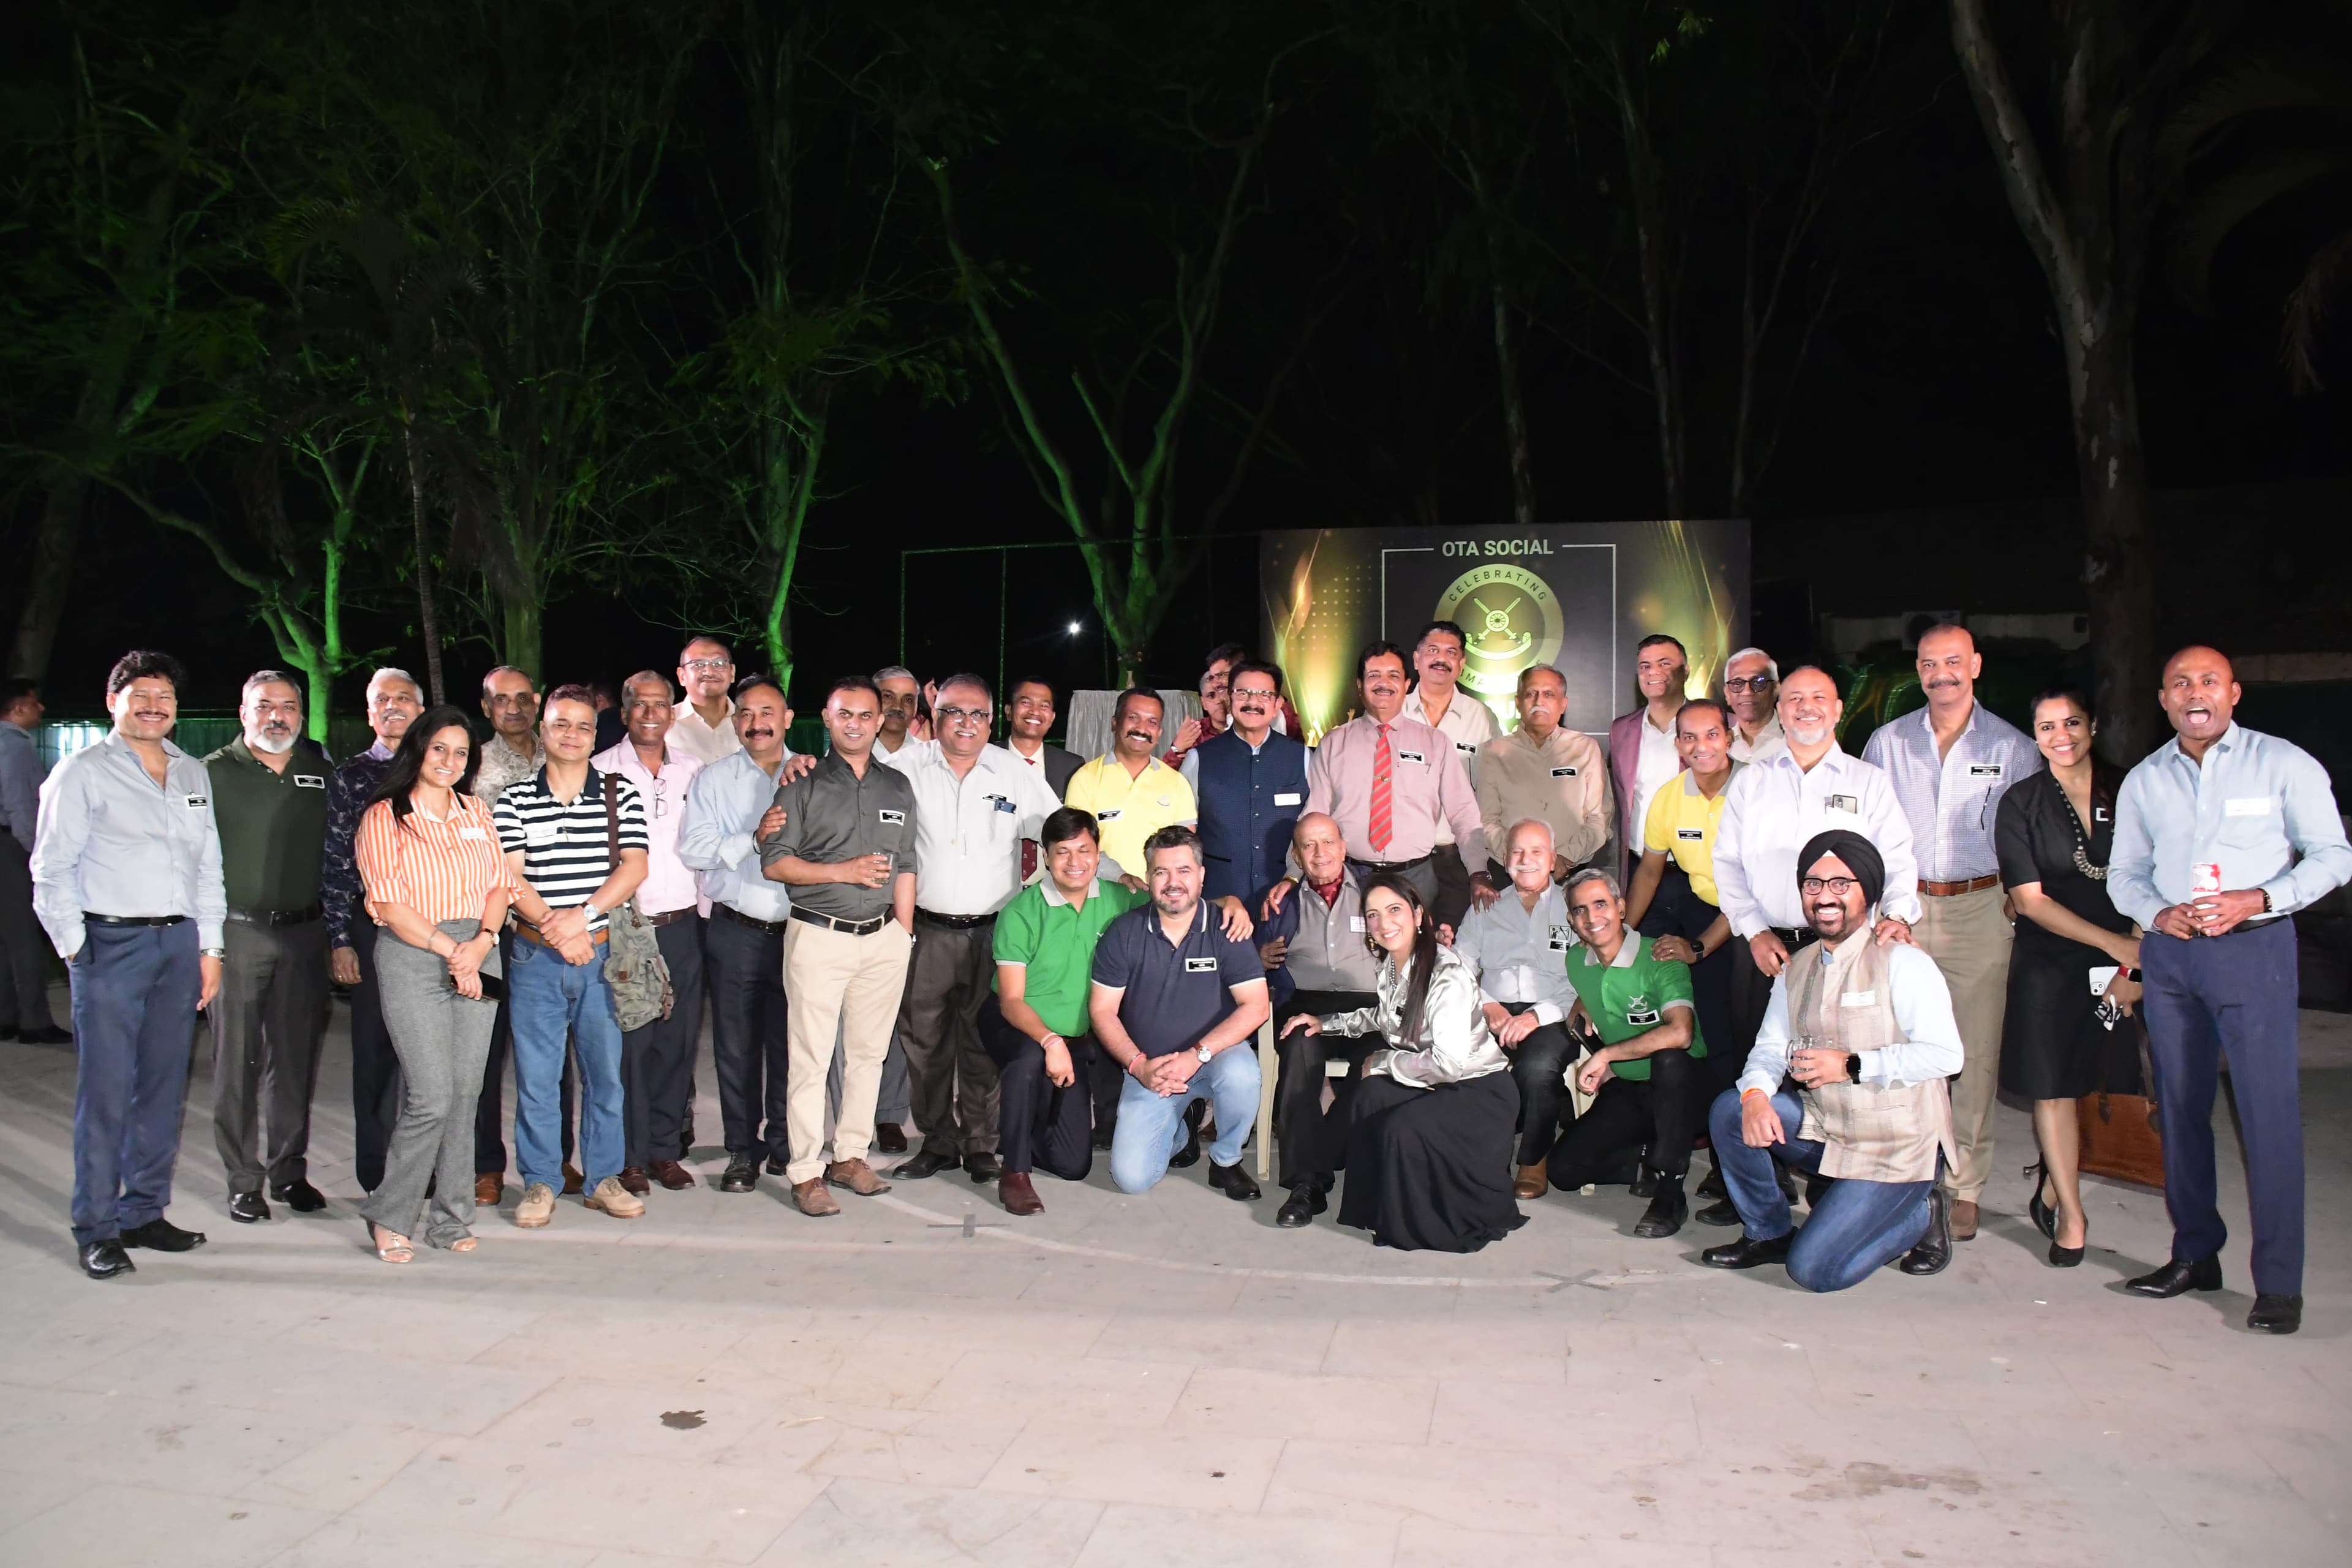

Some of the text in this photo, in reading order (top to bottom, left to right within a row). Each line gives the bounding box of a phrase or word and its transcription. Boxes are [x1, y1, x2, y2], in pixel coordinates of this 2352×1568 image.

[1442, 539, 1553, 557] OTA SOCIAL
[1449, 570, 1547, 601] CELEBRATING
